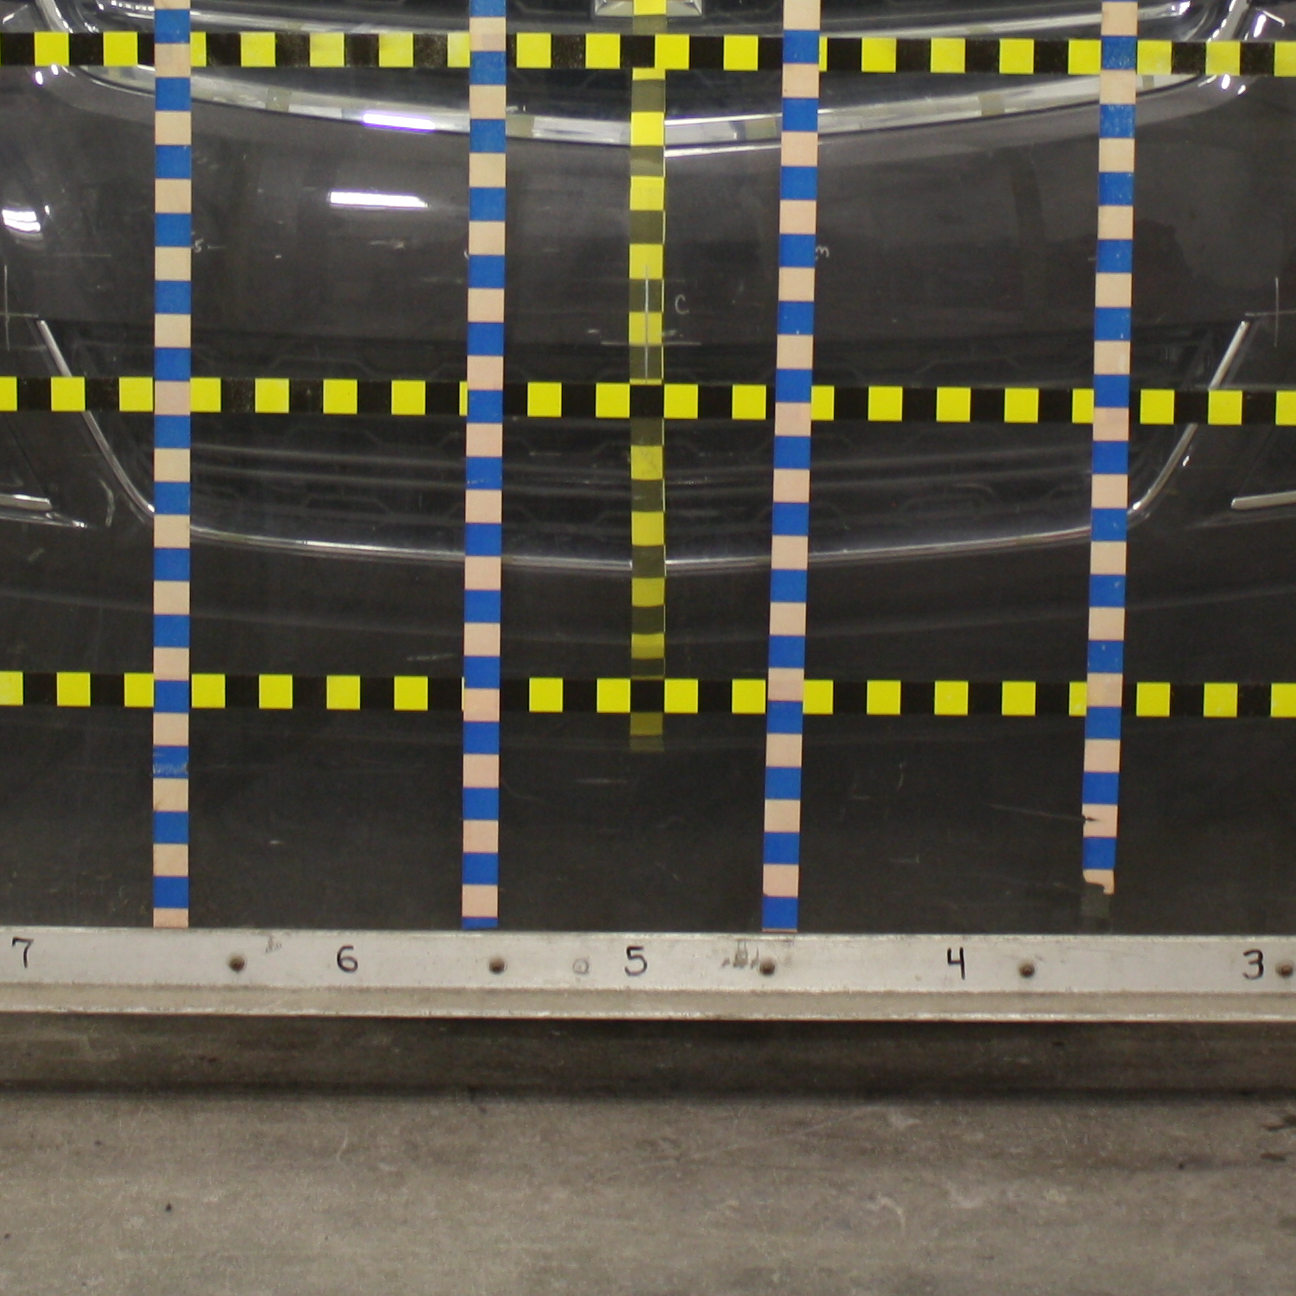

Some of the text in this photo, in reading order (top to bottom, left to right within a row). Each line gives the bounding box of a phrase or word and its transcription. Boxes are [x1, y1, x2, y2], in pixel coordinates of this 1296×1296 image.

[674, 294, 690, 315] C
[11, 936, 34, 969] 7
[336, 944, 359, 974] 6
[624, 944, 648, 977] 5
[946, 946, 966, 981] 4
[1242, 948, 1265, 981] 3
